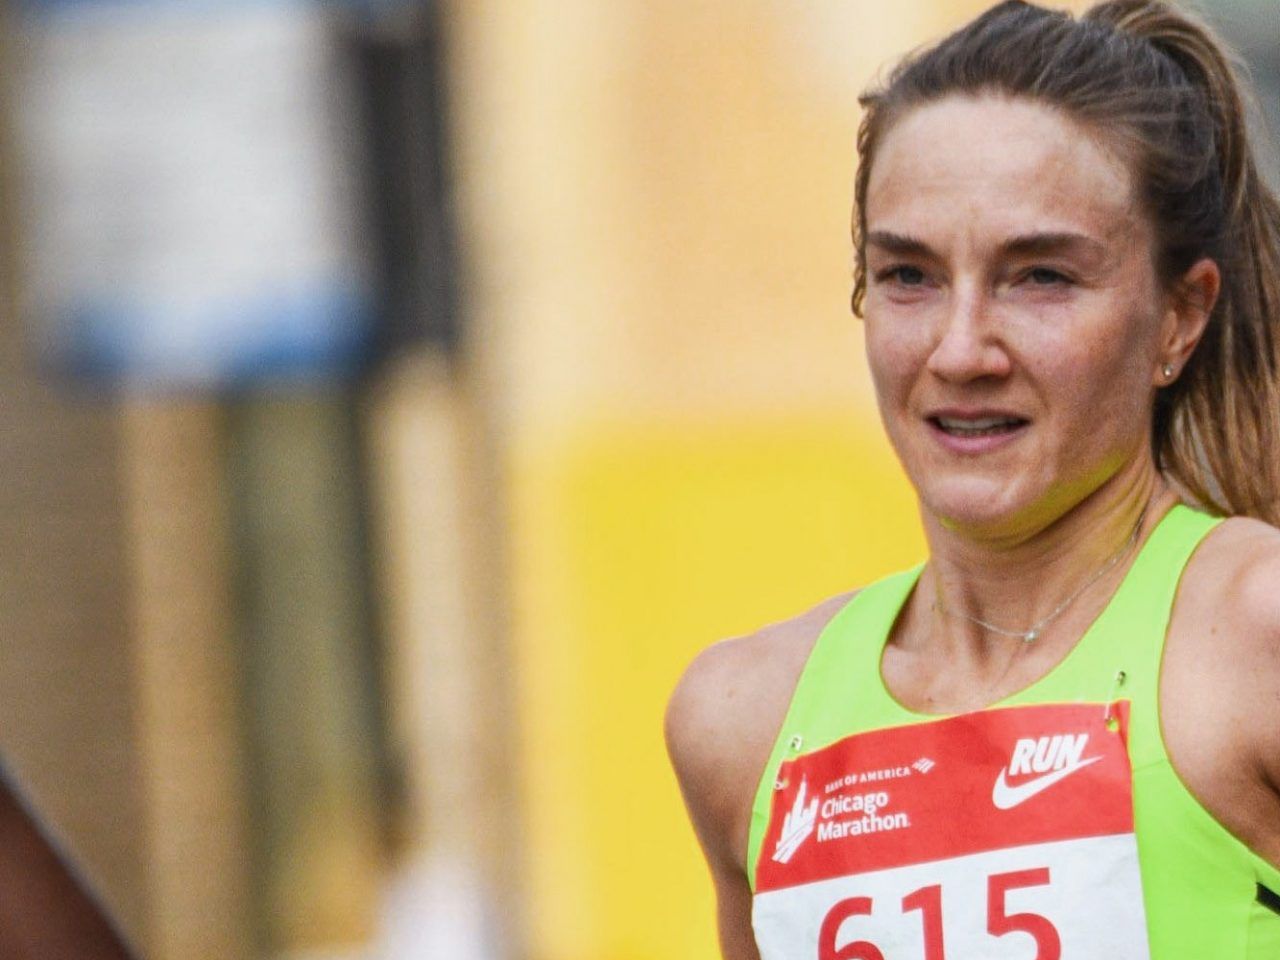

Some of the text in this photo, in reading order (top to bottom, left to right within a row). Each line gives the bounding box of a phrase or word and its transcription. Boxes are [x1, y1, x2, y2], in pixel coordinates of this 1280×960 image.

[1008, 733, 1088, 776] RUN
[844, 774, 858, 786] OF
[860, 767, 911, 783] AMERICA
[822, 792, 888, 819] Chicago
[817, 813, 910, 842] Marathon
